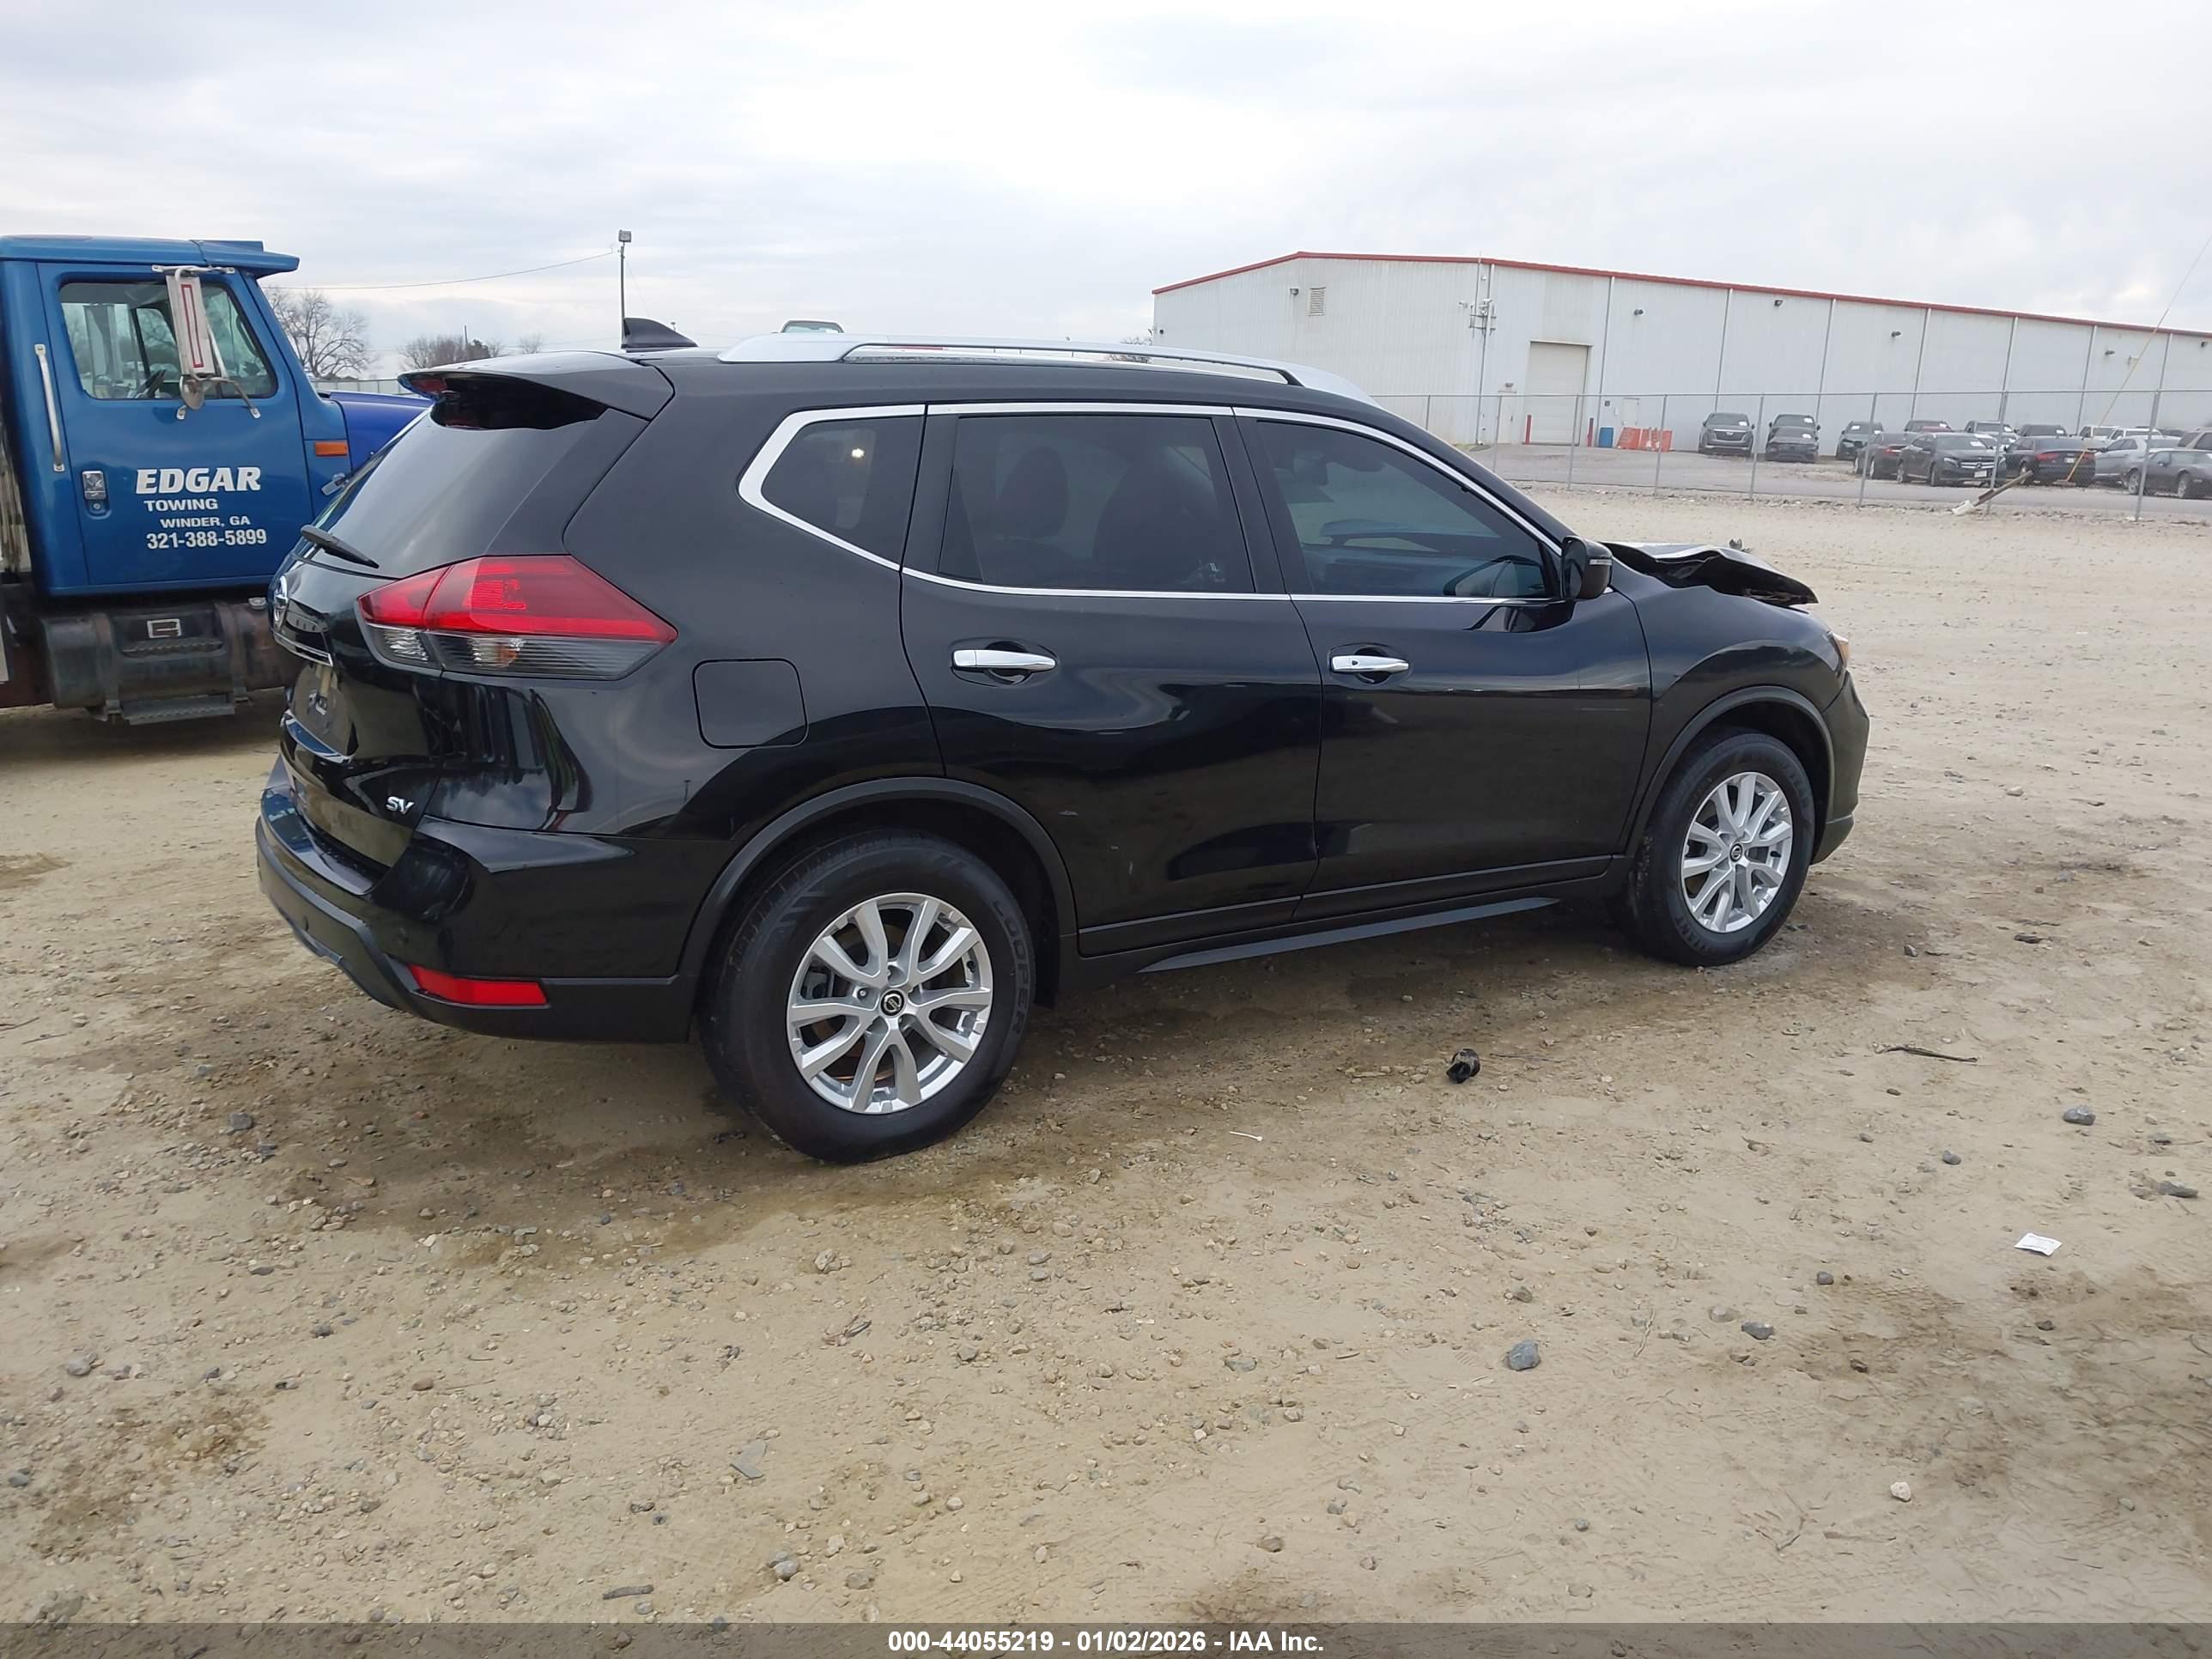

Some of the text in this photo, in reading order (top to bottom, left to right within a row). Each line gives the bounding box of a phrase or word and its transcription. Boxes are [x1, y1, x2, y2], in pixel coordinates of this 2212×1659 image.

[136, 466, 262, 495] EDGAR
[143, 498, 218, 512] TOWING
[160, 515, 252, 529] WINDER, GA
[146, 528, 268, 550] 321-388-5899
[386, 795, 416, 815] SV
